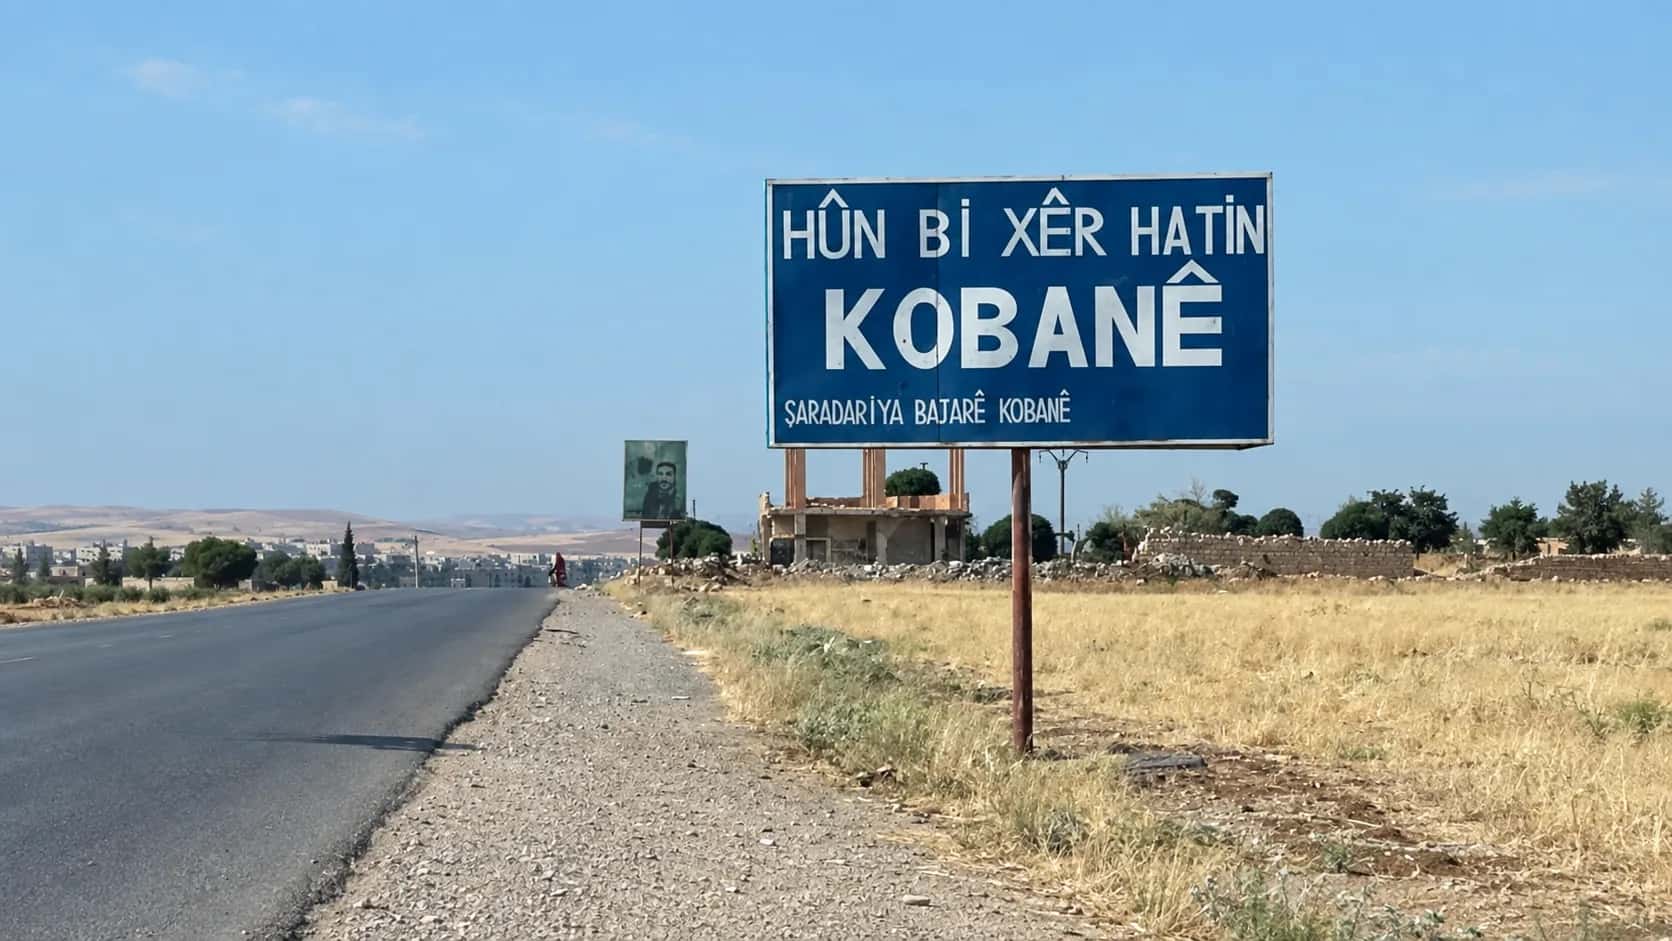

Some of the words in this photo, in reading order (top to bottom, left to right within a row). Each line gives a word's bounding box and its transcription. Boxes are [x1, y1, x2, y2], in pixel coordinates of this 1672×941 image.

[783, 189, 886, 260] HÛN
[1001, 187, 1107, 257] XÊR
[825, 259, 1223, 371] KOBANÊ
[914, 389, 986, 425] BAJARÊ
[998, 389, 1071, 424] KOBANÊ
